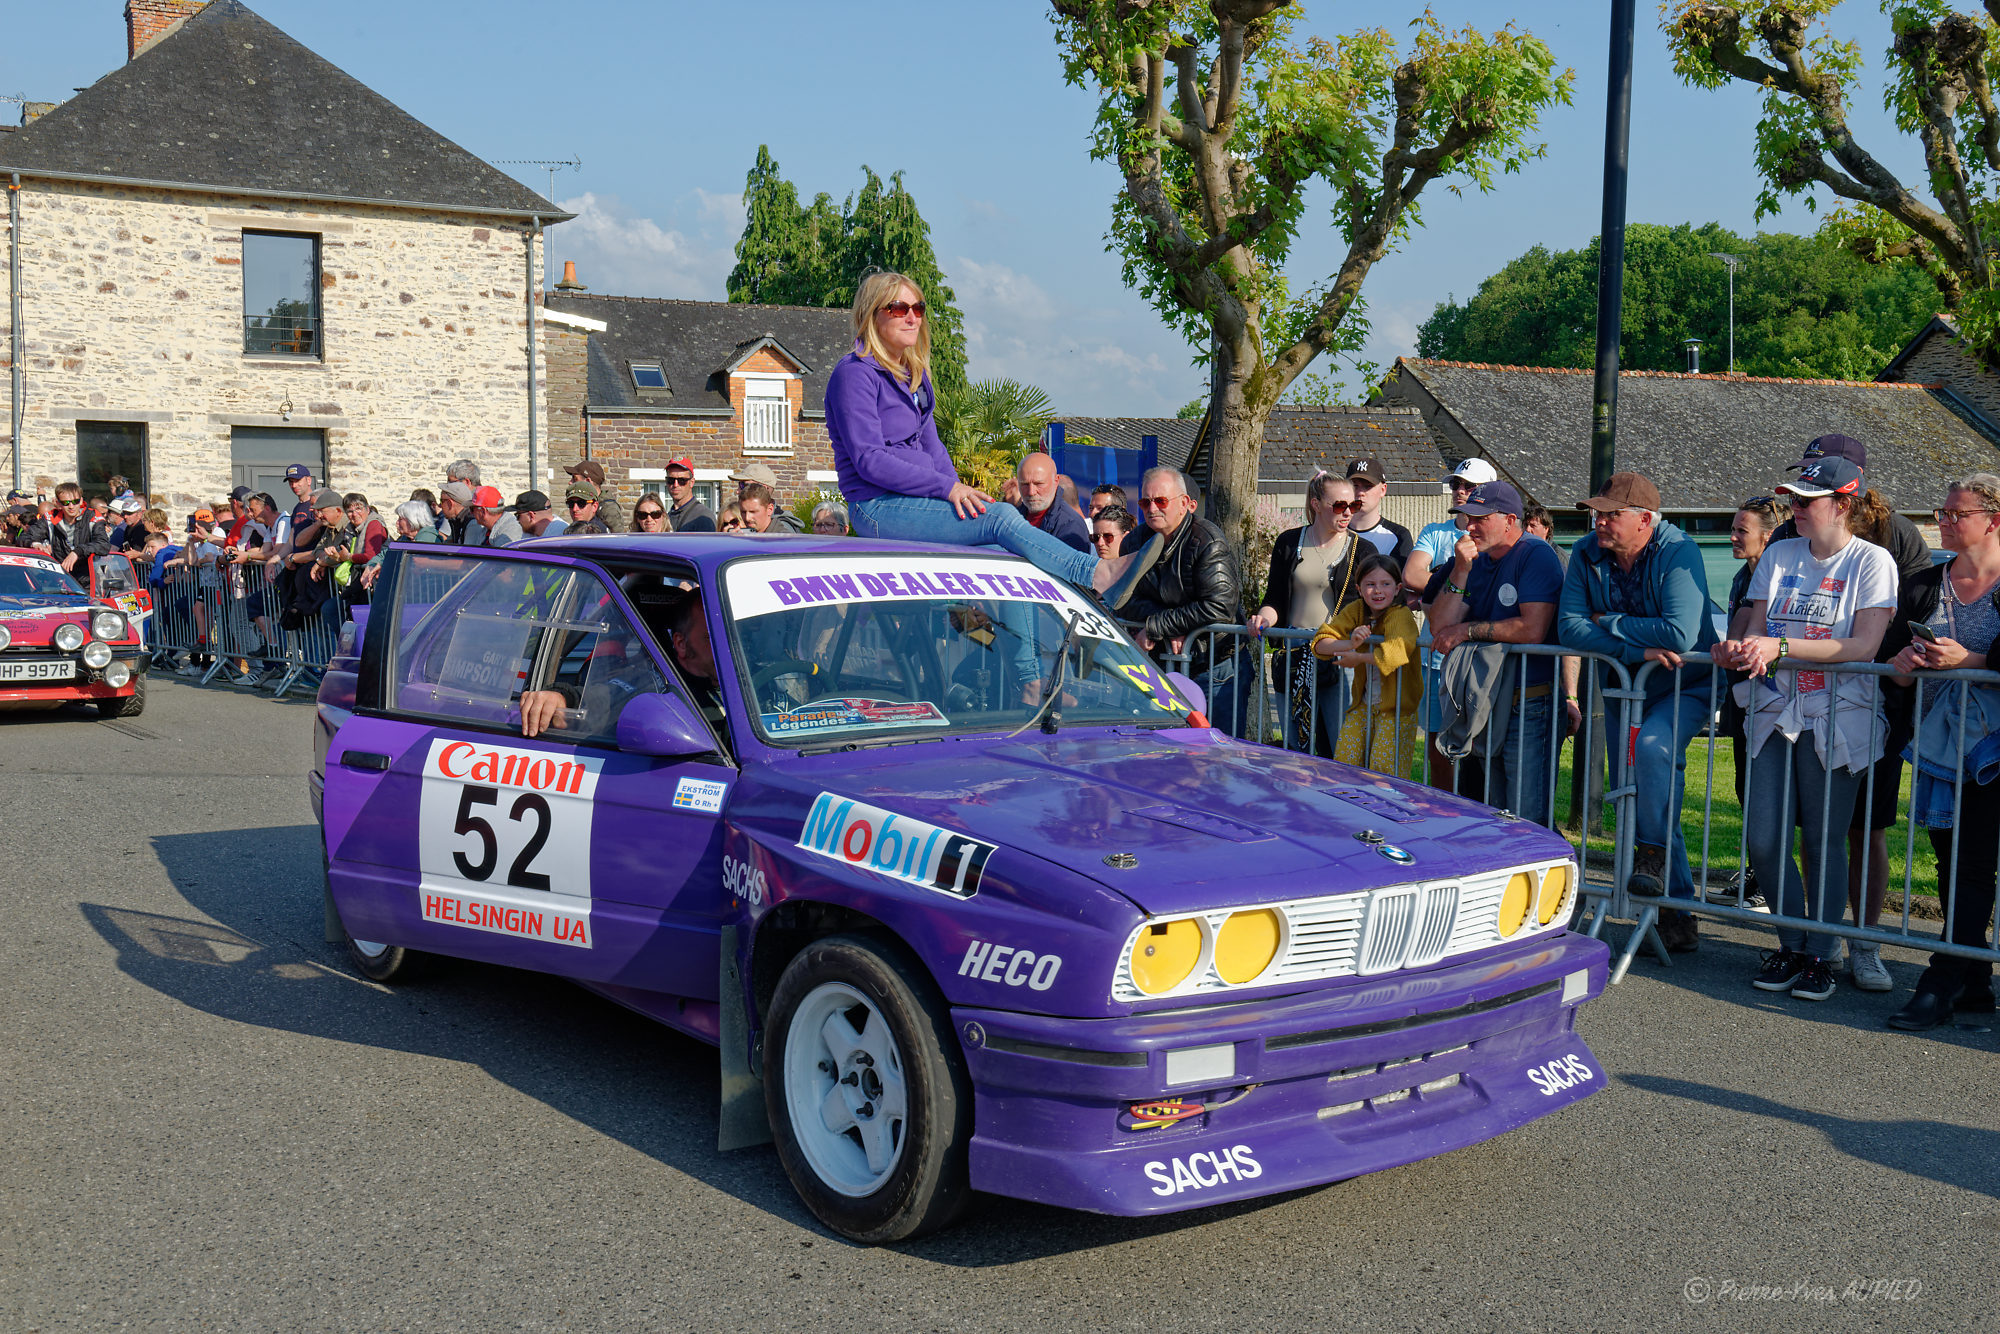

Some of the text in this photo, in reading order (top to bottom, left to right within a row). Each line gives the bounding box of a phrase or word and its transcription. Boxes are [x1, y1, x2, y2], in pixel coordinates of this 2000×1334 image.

[37, 560, 57, 571] 61
[768, 572, 1068, 606] BMW DEALER TEAM
[0, 664, 69, 678] HP 997R
[778, 711, 837, 723] Parade
[438, 742, 586, 794] Canon
[452, 784, 551, 892] 52
[803, 794, 978, 893] Mobil 1
[722, 854, 765, 906] SACHS
[425, 895, 587, 944] HELSINGIN UA
[957, 940, 1063, 991] HECO
[1526, 1053, 1594, 1096] SACHS
[1144, 1145, 1263, 1196] SACHS
